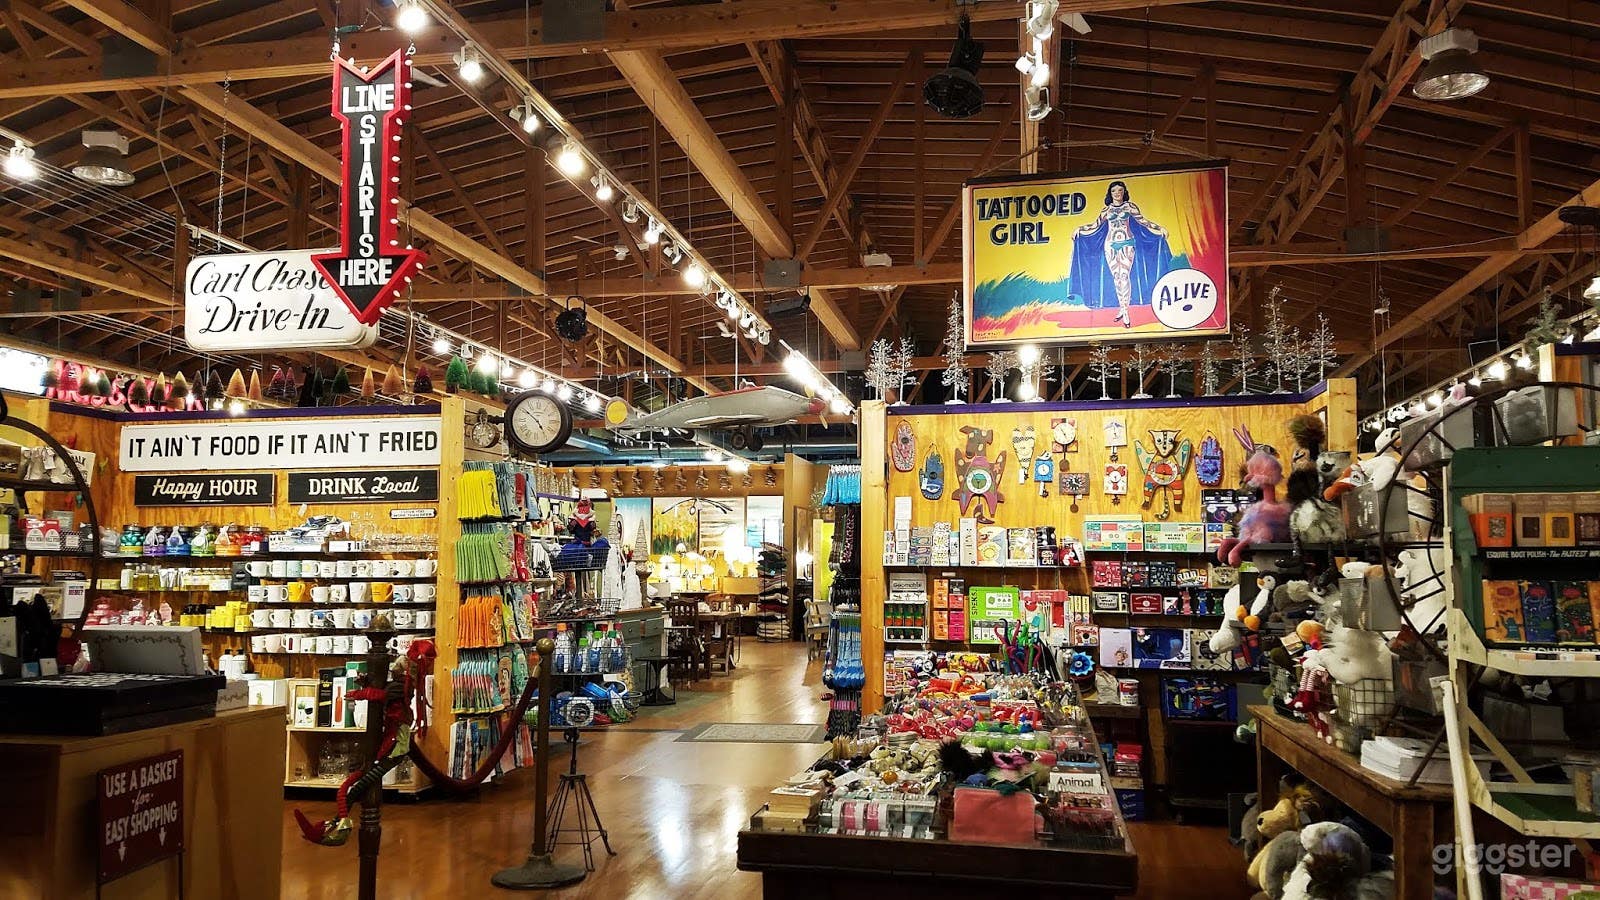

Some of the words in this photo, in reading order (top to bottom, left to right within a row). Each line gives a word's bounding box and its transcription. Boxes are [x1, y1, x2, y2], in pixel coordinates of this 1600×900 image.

[342, 83, 395, 113] LINE
[358, 114, 377, 258] STARTS
[977, 192, 1087, 221] TATTOOED
[990, 221, 1050, 246] GIRL
[190, 260, 250, 296] Carl
[339, 258, 394, 287] HERE
[1158, 282, 1211, 311] ALIVE
[198, 293, 345, 334] Drive-In
[129, 438, 146, 458] IT
[210, 435, 260, 456] FOOD
[267, 434, 284, 455] IF
[290, 434, 308, 454] IT
[379, 430, 438, 452] FRIED
[151, 477, 205, 500] Happy
[208, 479, 258, 496] HOUR
[308, 477, 367, 495] DRINK
[371, 476, 420, 494] Local
[105, 771, 127, 798] USE
[129, 769, 138, 792] A
[140, 758, 178, 789] BASKET
[1057, 776, 1094, 788] Animal
[105, 815, 131, 846] EASY
[130, 800, 178, 837] SHOPPING
